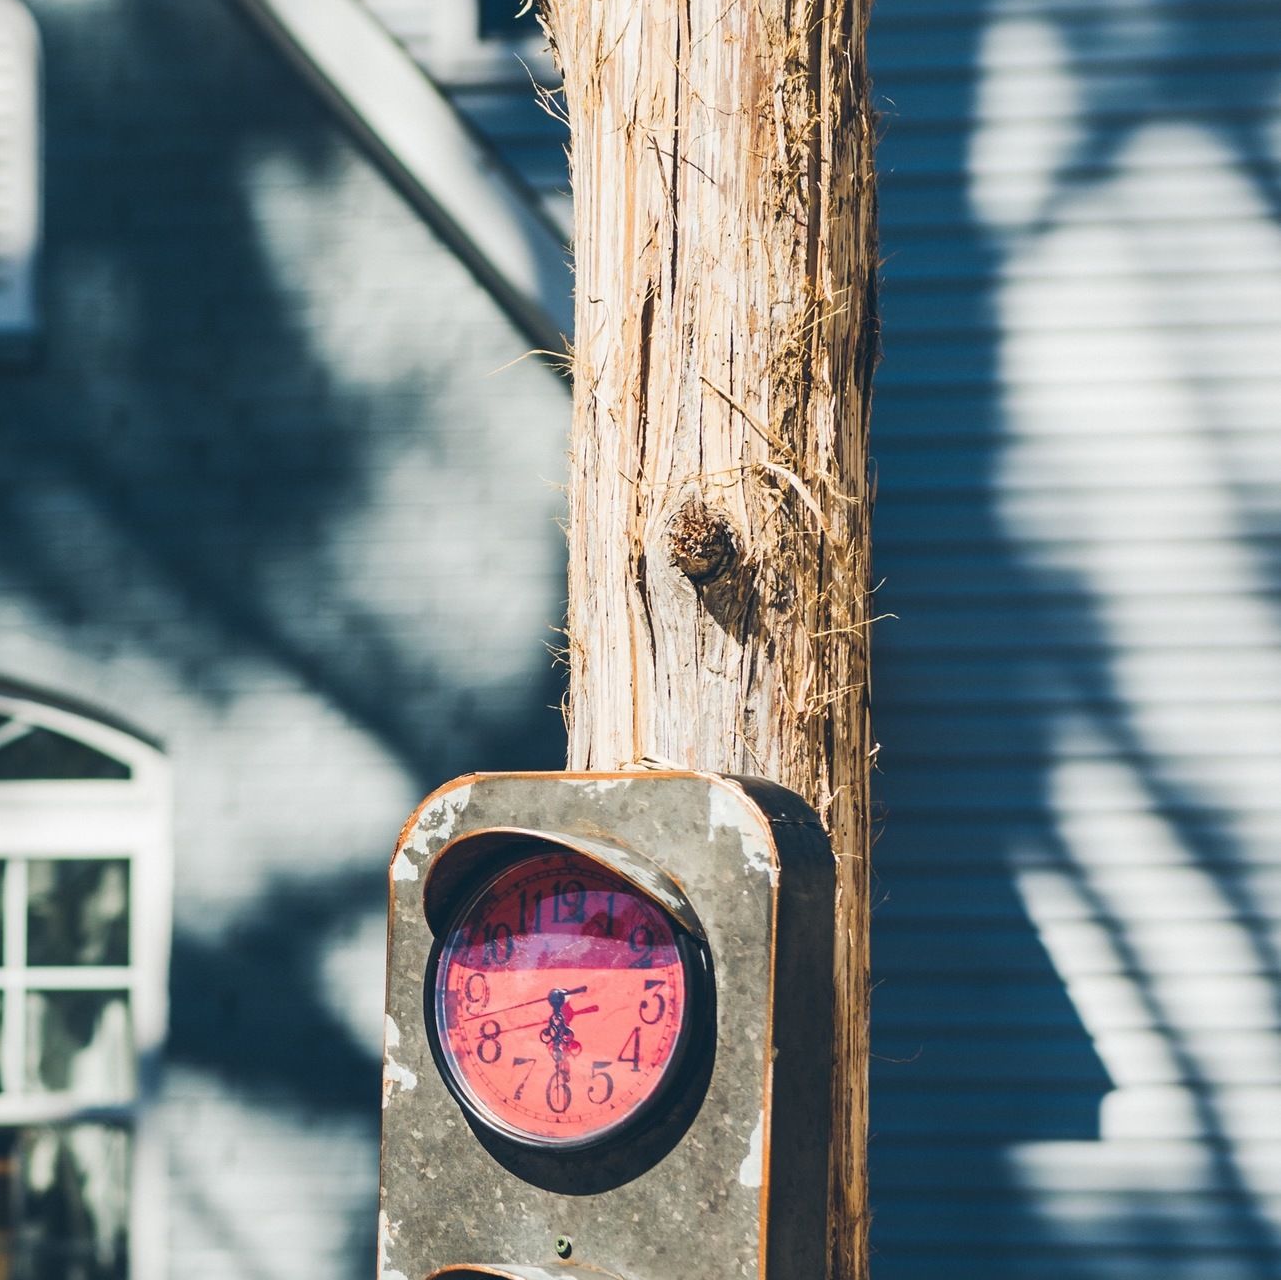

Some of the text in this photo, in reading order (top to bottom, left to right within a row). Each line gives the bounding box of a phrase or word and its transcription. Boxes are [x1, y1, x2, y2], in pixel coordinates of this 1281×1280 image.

[518, 889, 542, 933] 11
[552, 879, 586, 923] 12
[604, 892, 615, 936] 1
[480, 923, 514, 965] 10
[628, 925, 654, 968] 2
[464, 973, 490, 1016] 9
[639, 979, 666, 1024] 3
[476, 1020, 502, 1063] 8
[618, 1026, 640, 1072] 4
[512, 1057, 537, 1100] 7
[587, 1061, 613, 1104] 5
